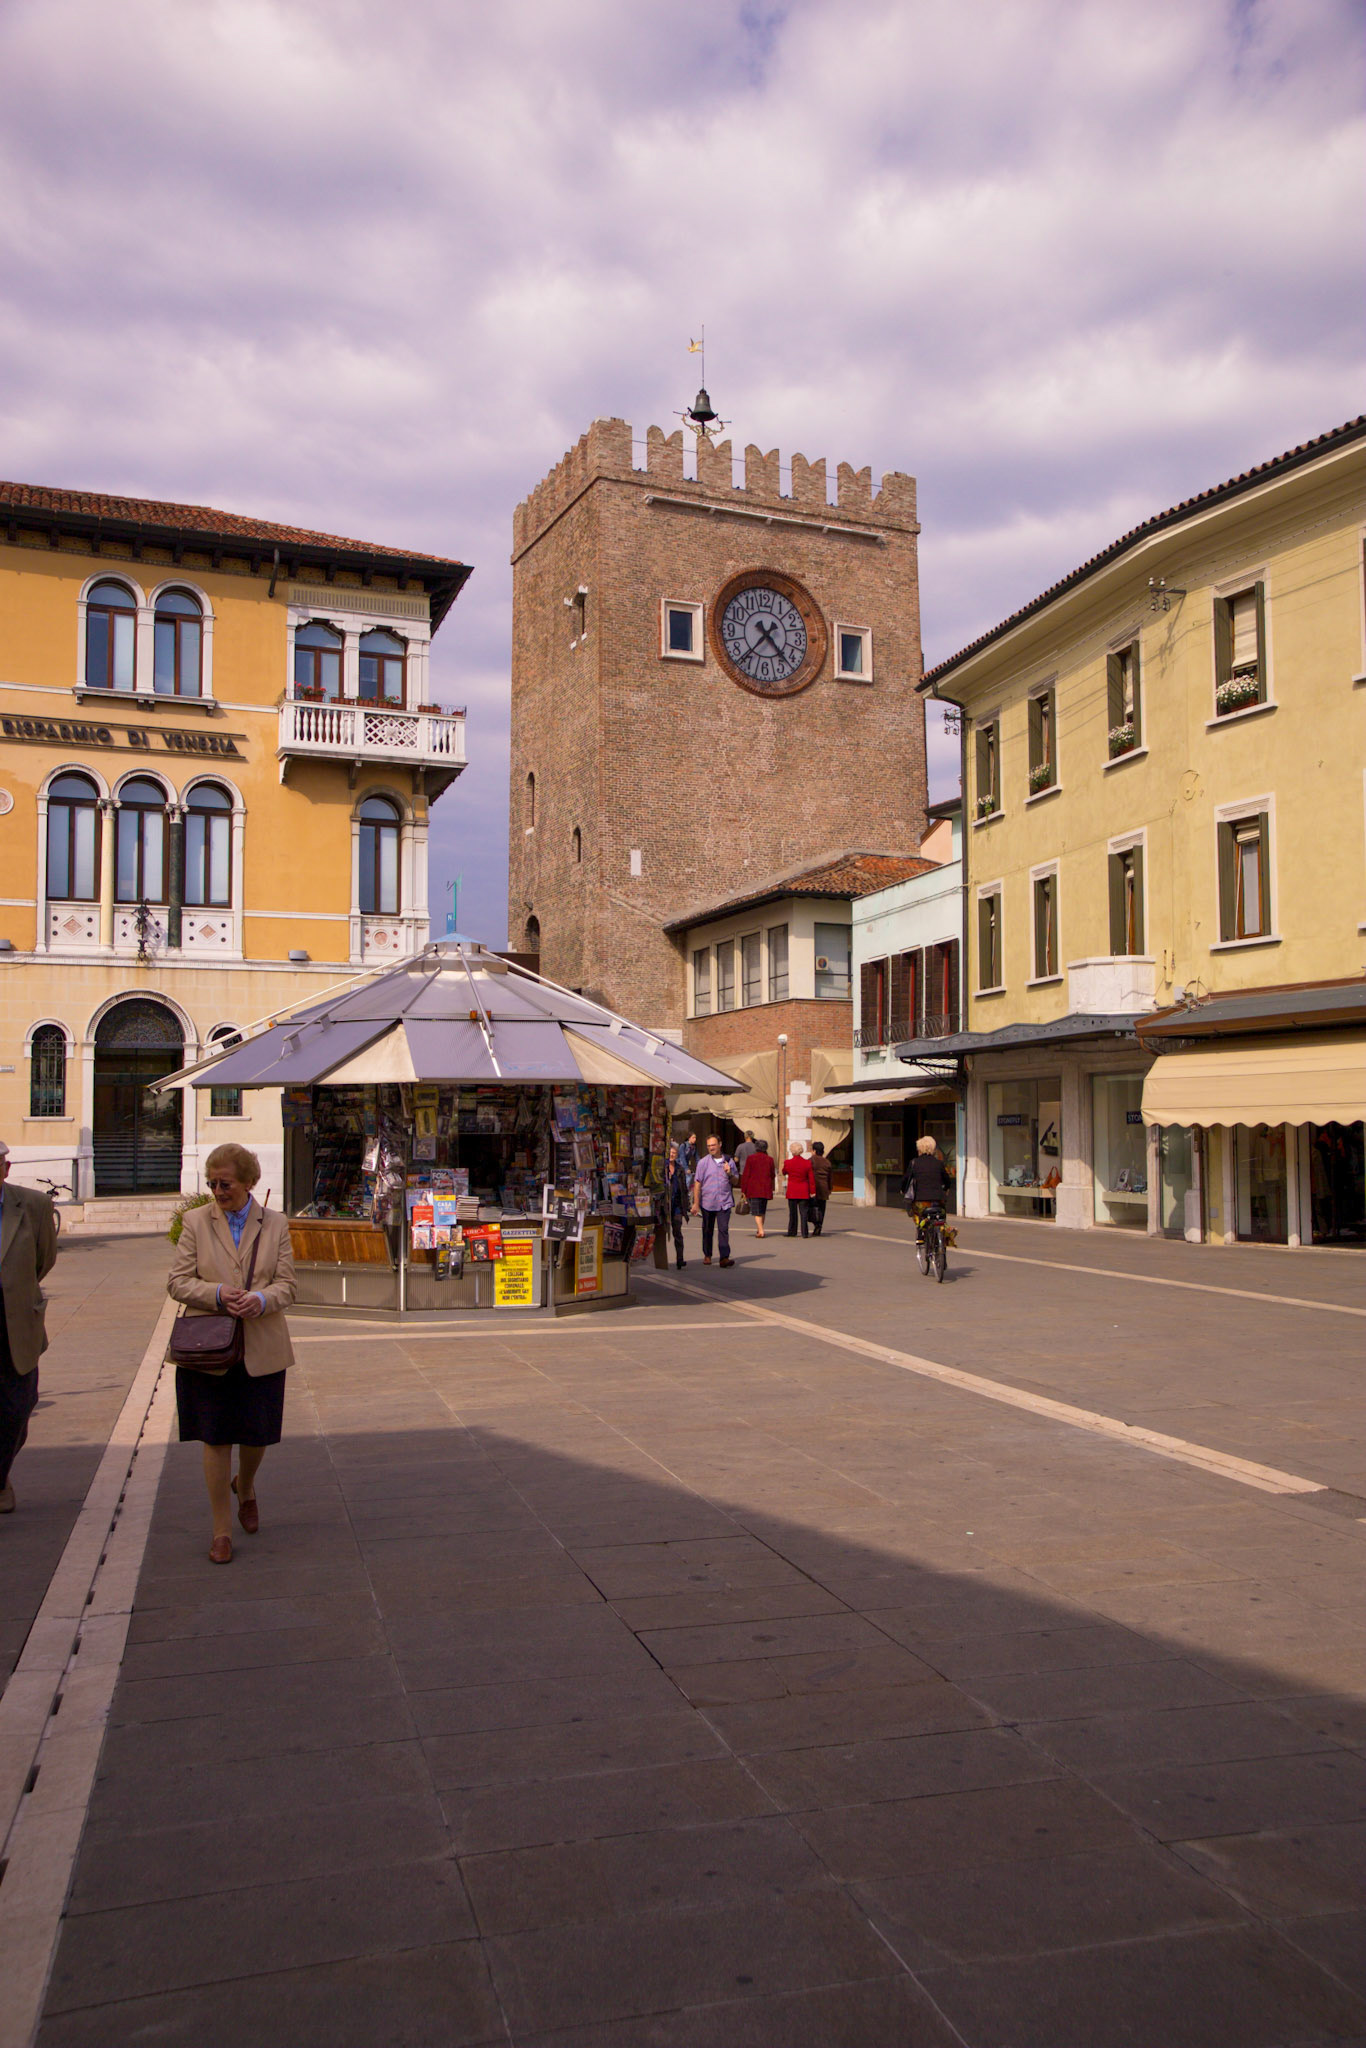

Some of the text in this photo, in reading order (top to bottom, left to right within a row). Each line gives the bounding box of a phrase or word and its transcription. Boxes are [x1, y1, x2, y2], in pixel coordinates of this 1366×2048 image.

[745, 596, 754, 610] 11
[759, 594, 770, 608] 12
[778, 601, 782, 614] 1
[732, 606, 744, 620] 10
[788, 613, 796, 627] 2
[727, 623, 735, 637] 9
[794, 632, 802, 646] 3
[732, 641, 741, 656] 8
[788, 648, 796, 662] 4
[746, 655, 753, 669] 7
[761, 661, 769, 675] 6
[776, 658, 784, 673] 5
[2, 719, 239, 753] RISPARMIO DI VENEZIA
